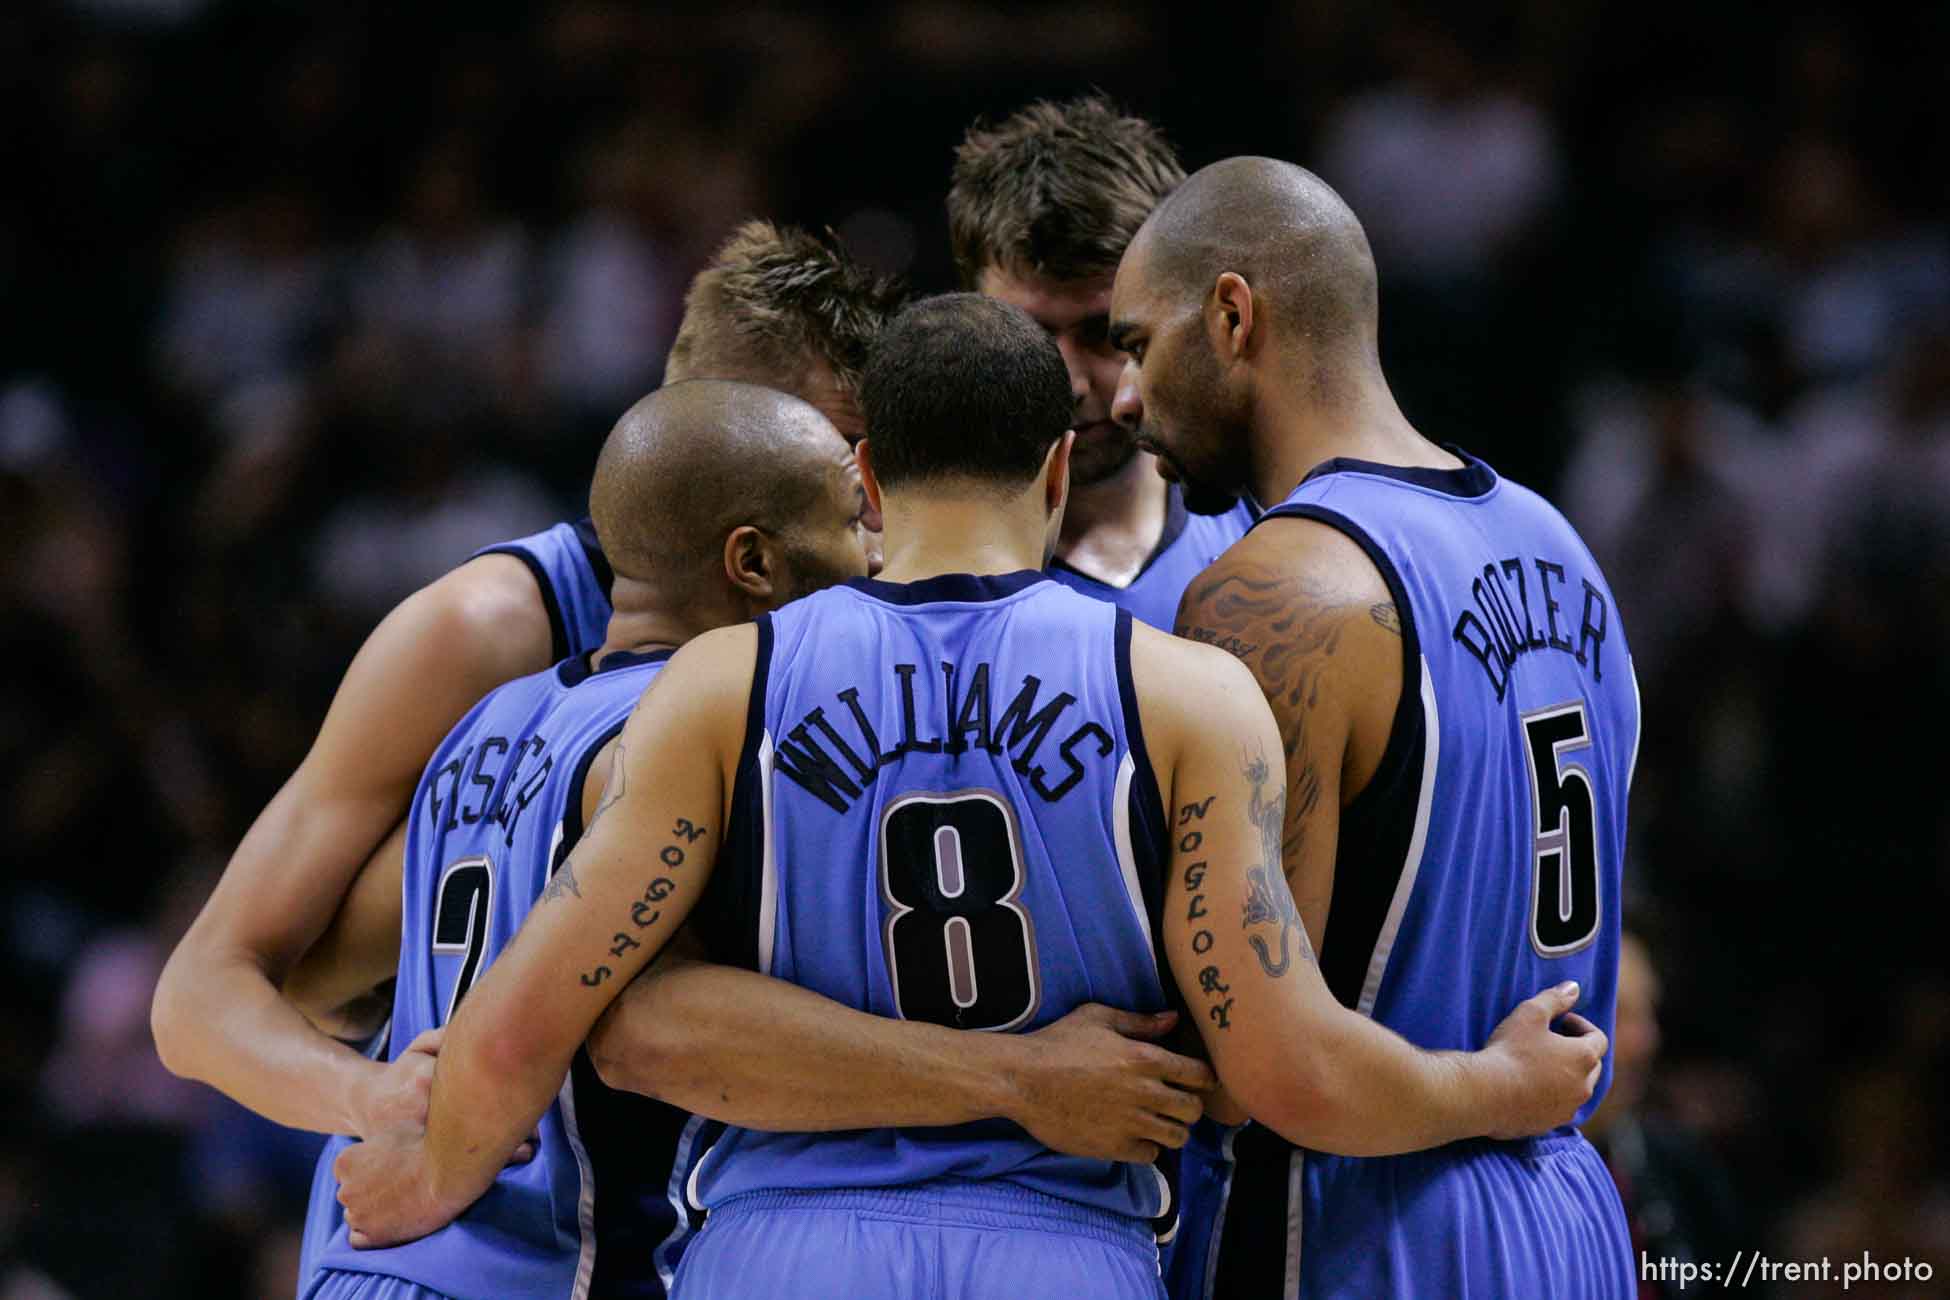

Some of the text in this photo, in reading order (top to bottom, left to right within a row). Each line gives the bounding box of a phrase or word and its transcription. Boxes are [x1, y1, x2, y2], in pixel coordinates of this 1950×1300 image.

[1453, 557, 1607, 704] BOOZER
[774, 661, 1114, 815] WILLIAMS
[1520, 700, 1602, 959] 5
[878, 787, 1042, 1033] 8
